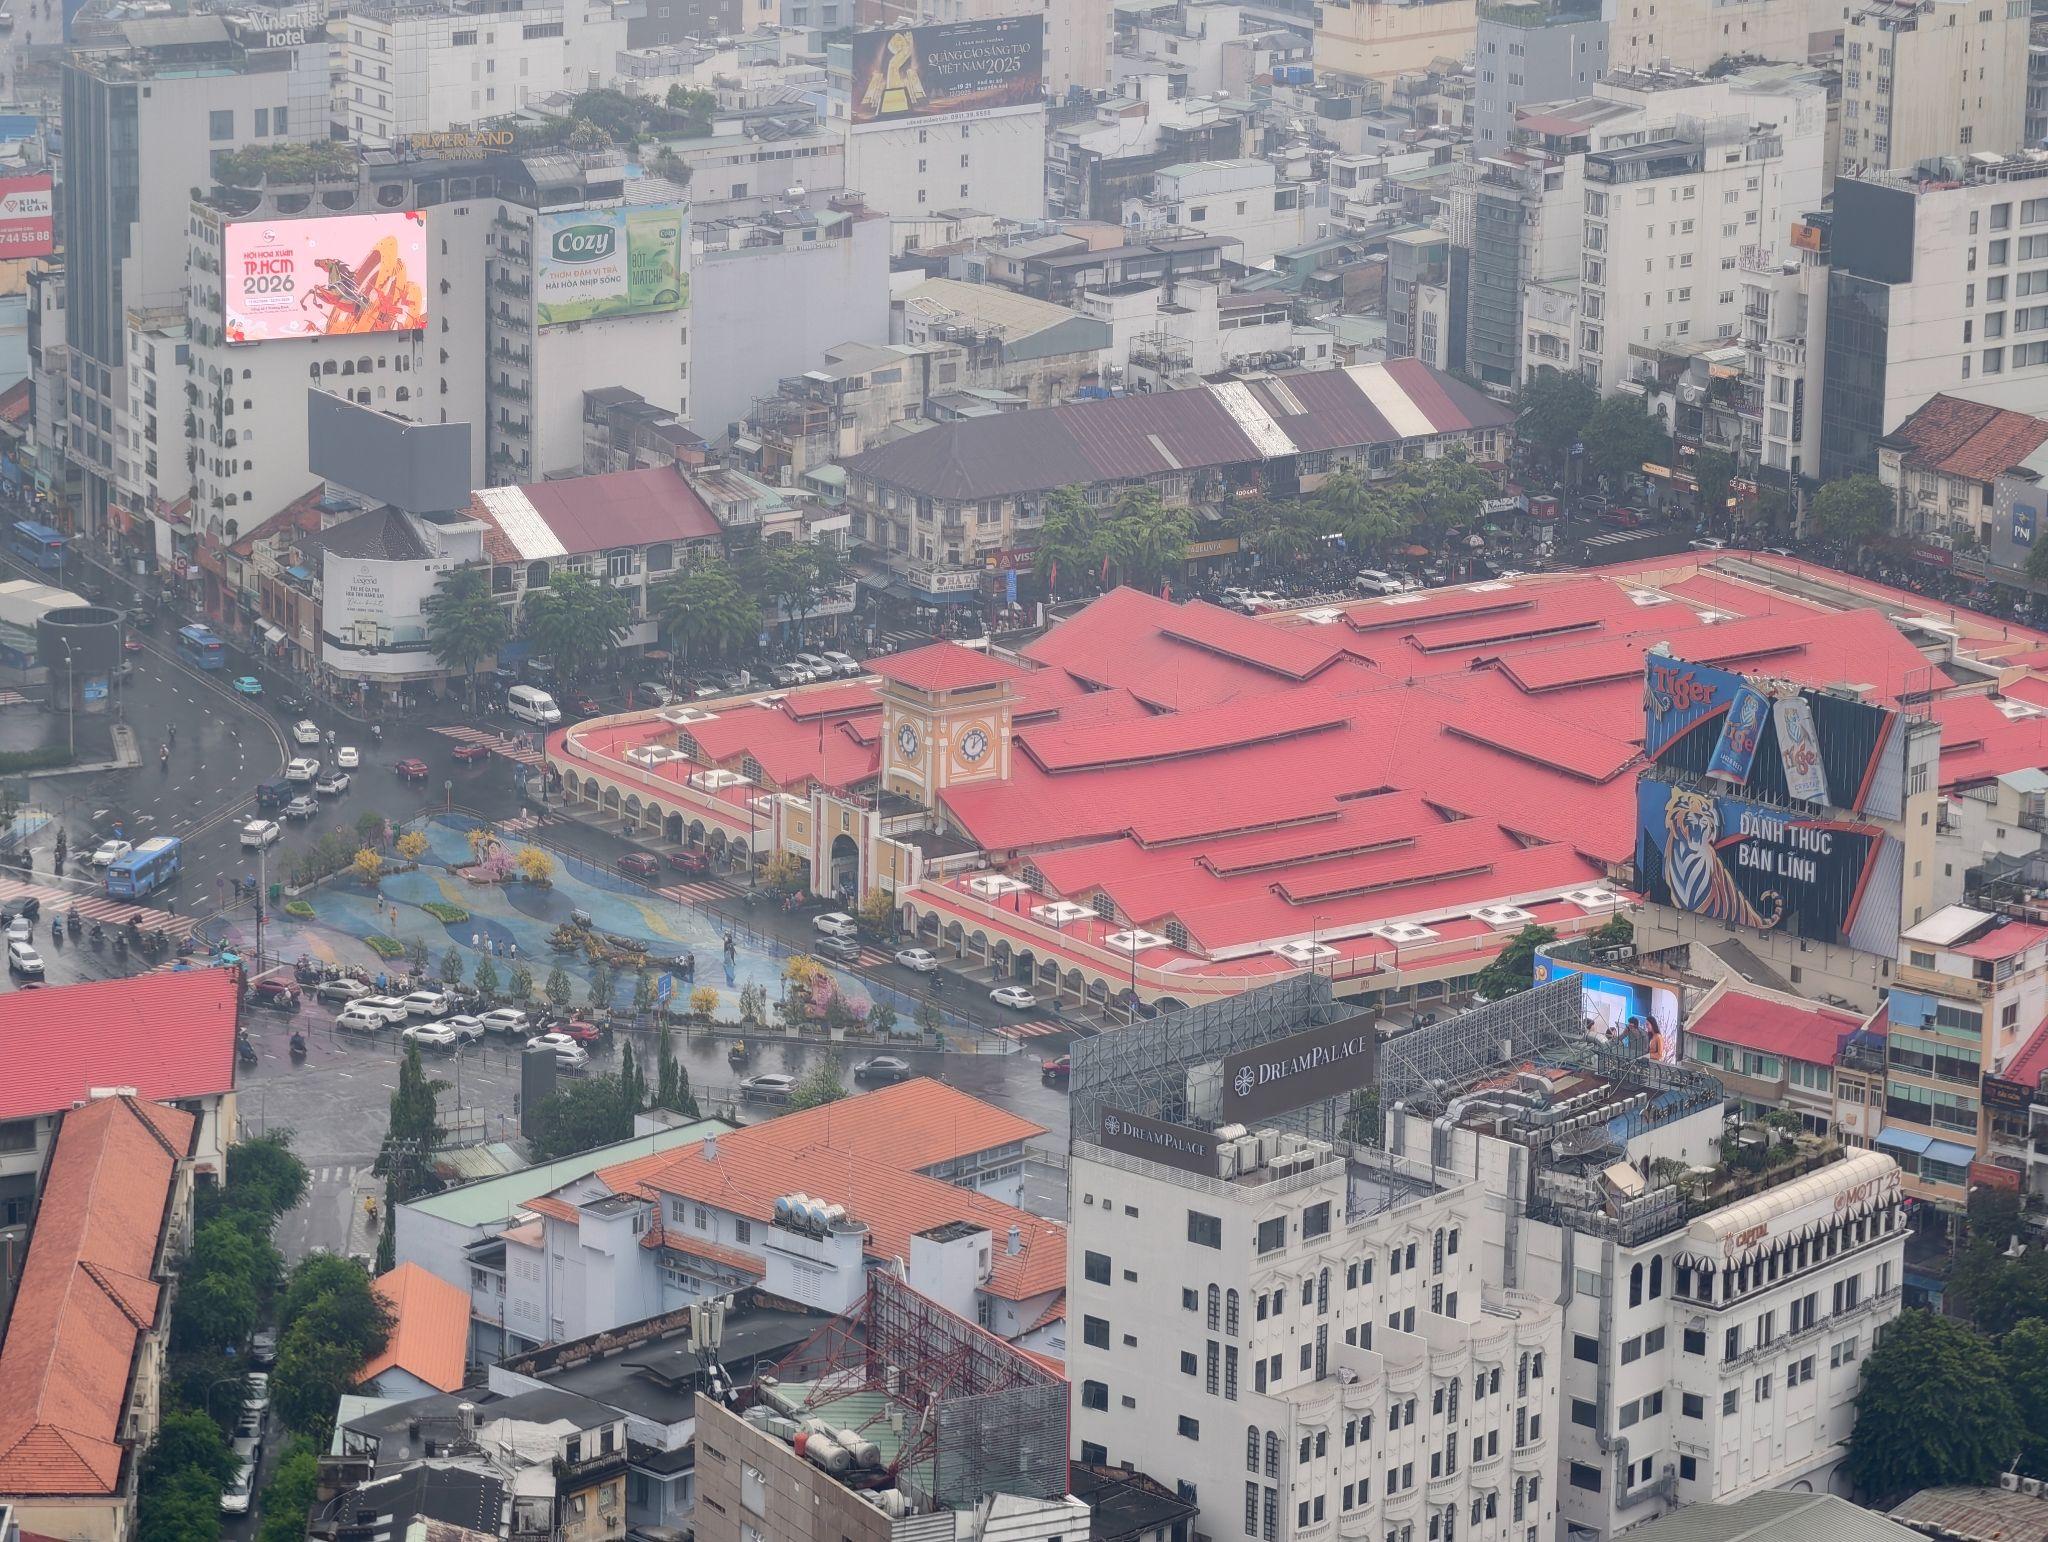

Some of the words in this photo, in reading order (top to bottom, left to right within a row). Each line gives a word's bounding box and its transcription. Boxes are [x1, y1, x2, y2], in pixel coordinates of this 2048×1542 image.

[266, 28, 305, 47] hotel
[985, 56, 1021, 75] 2025
[411, 129, 514, 150] SILVERLAND
[557, 232, 609, 254] Cozy
[244, 259, 294, 276] TP.HCM
[632, 268, 663, 286] MATCHA
[243, 274, 295, 295] 2026
[2014, 525, 2031, 542] PNJ
[1654, 665, 1717, 711] Tiger
[1740, 809, 1784, 844] ĐÁNH
[1788, 824, 1833, 856] THỨC
[1739, 842, 1773, 870] BẢN
[1777, 852, 1816, 884] LĨNH
[1258, 1034, 1369, 1086] DREAMPALACE
[1122, 1120, 1208, 1157] DREAMPALACE
